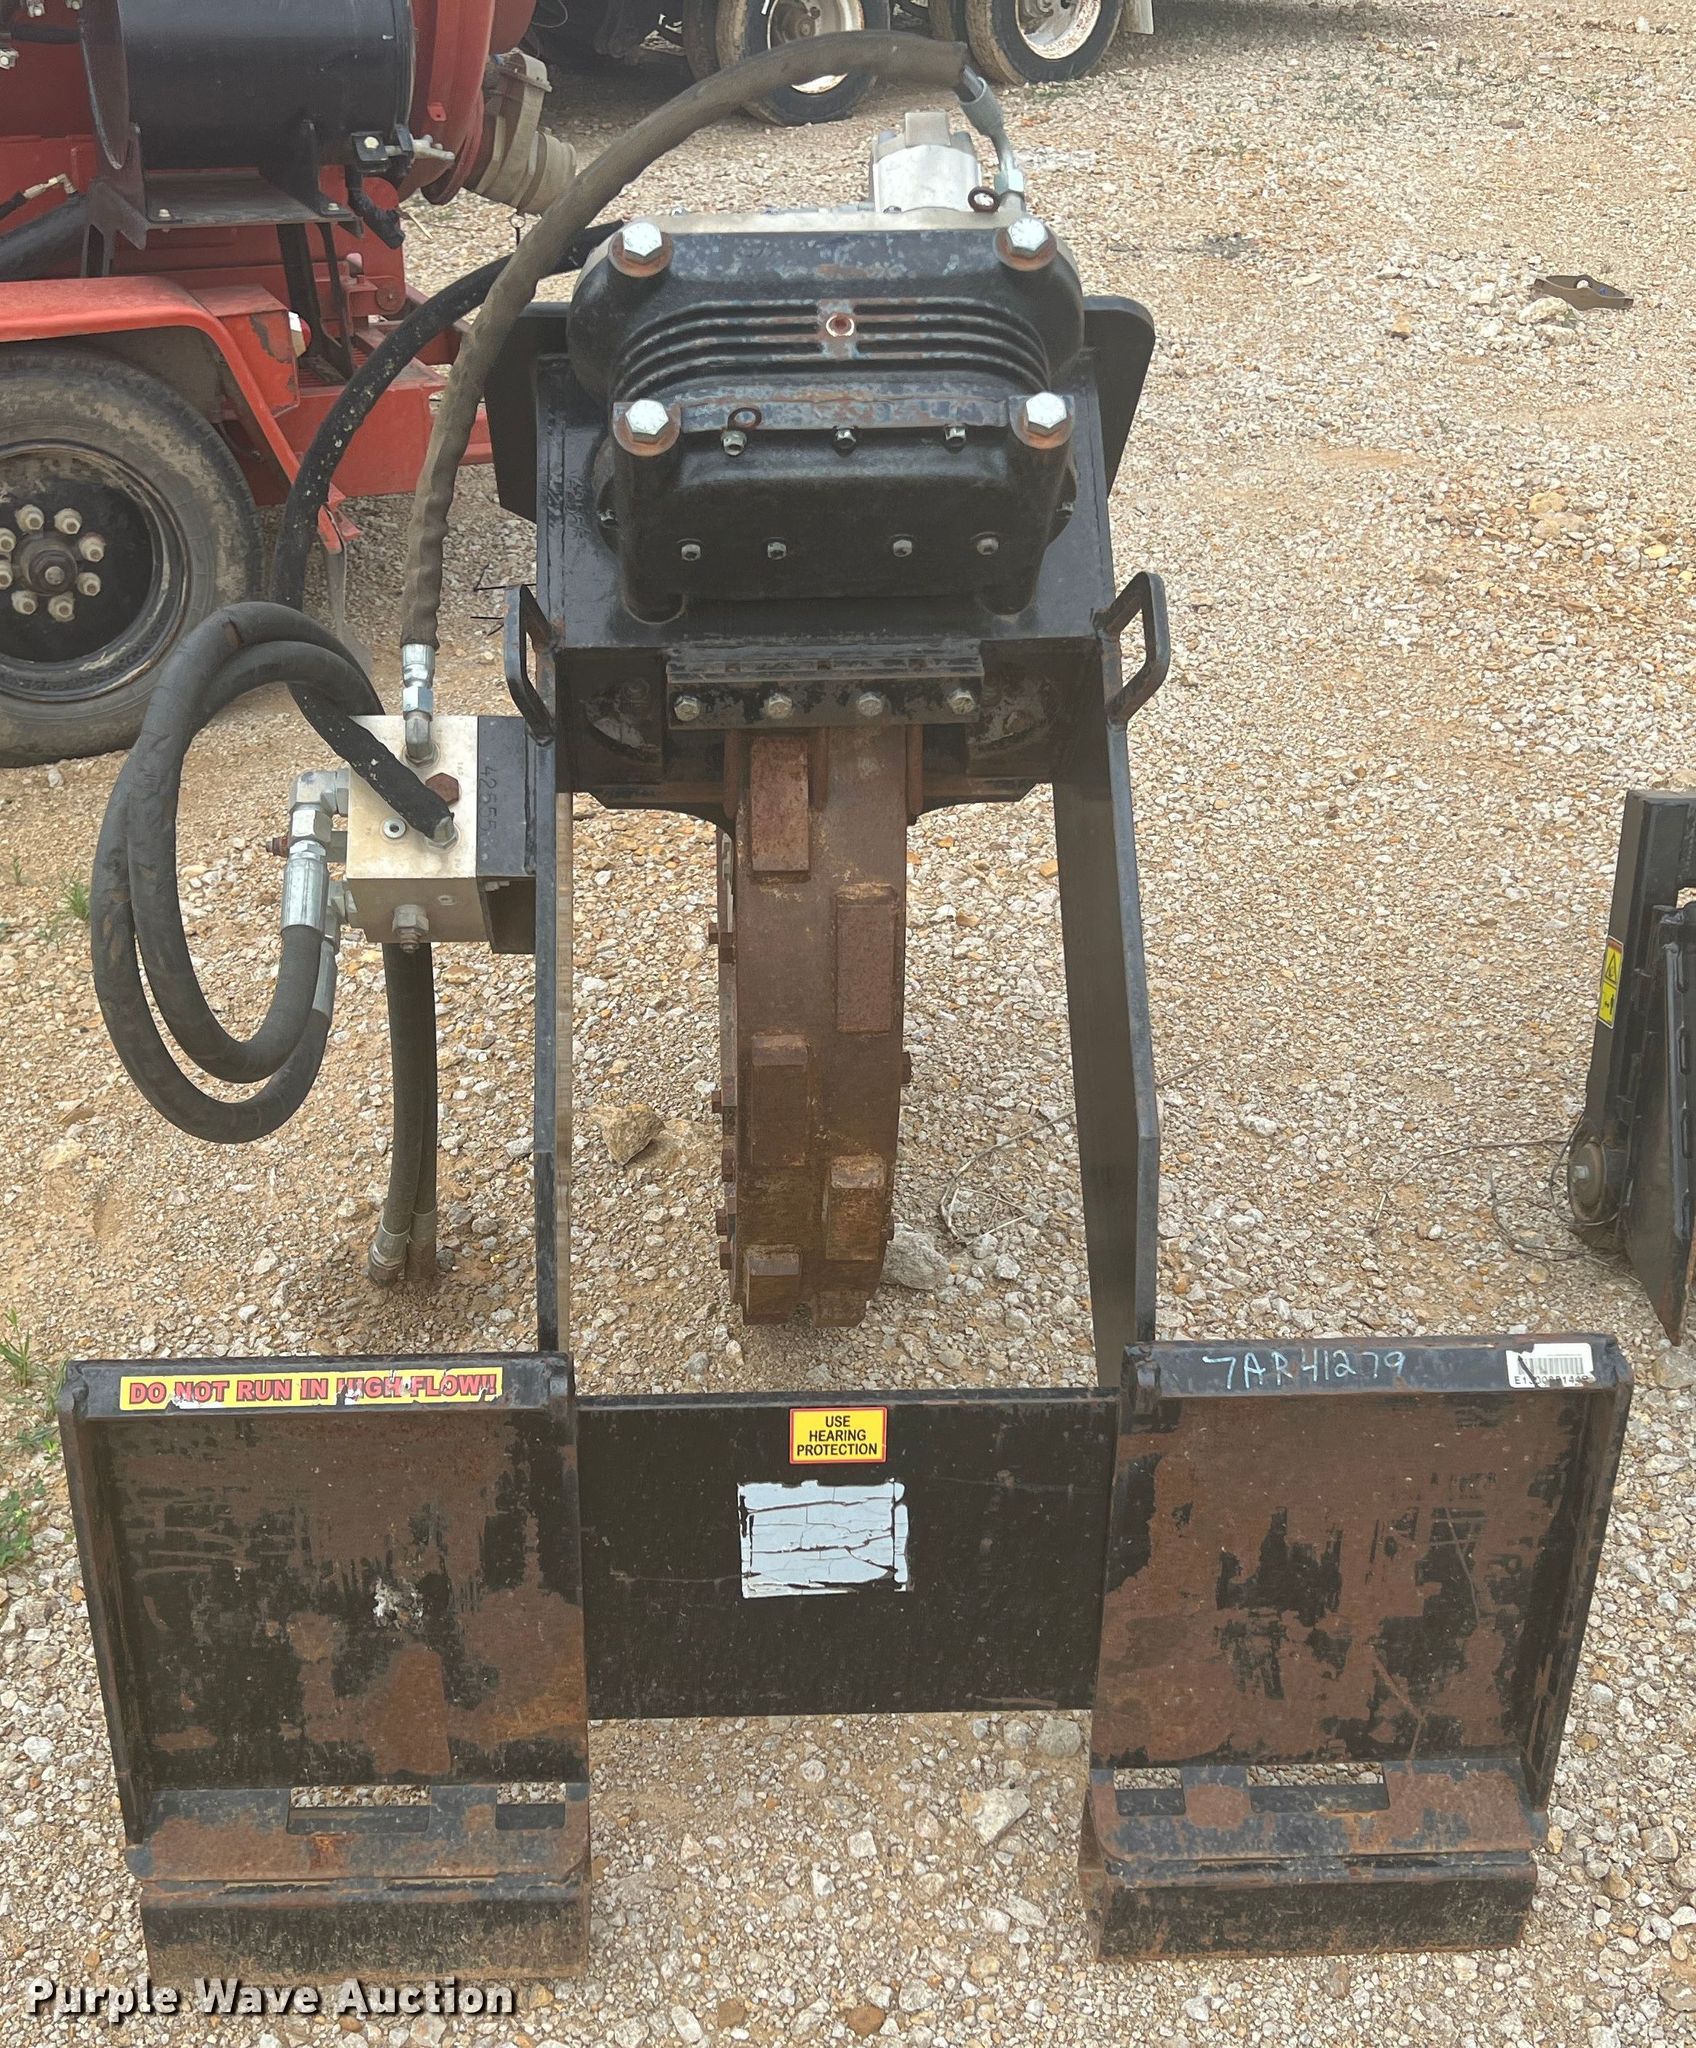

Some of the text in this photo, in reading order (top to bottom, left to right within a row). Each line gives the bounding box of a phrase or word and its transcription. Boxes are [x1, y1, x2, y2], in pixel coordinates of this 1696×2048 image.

[129, 1382, 167, 1405] DO
[174, 1379, 229, 1403] NOT
[235, 1378, 293, 1402] RUN
[301, 1377, 328, 1400] IN
[825, 1415, 851, 1428] USE
[809, 1429, 867, 1442] HEARING
[796, 1443, 878, 1457] PROTECTION
